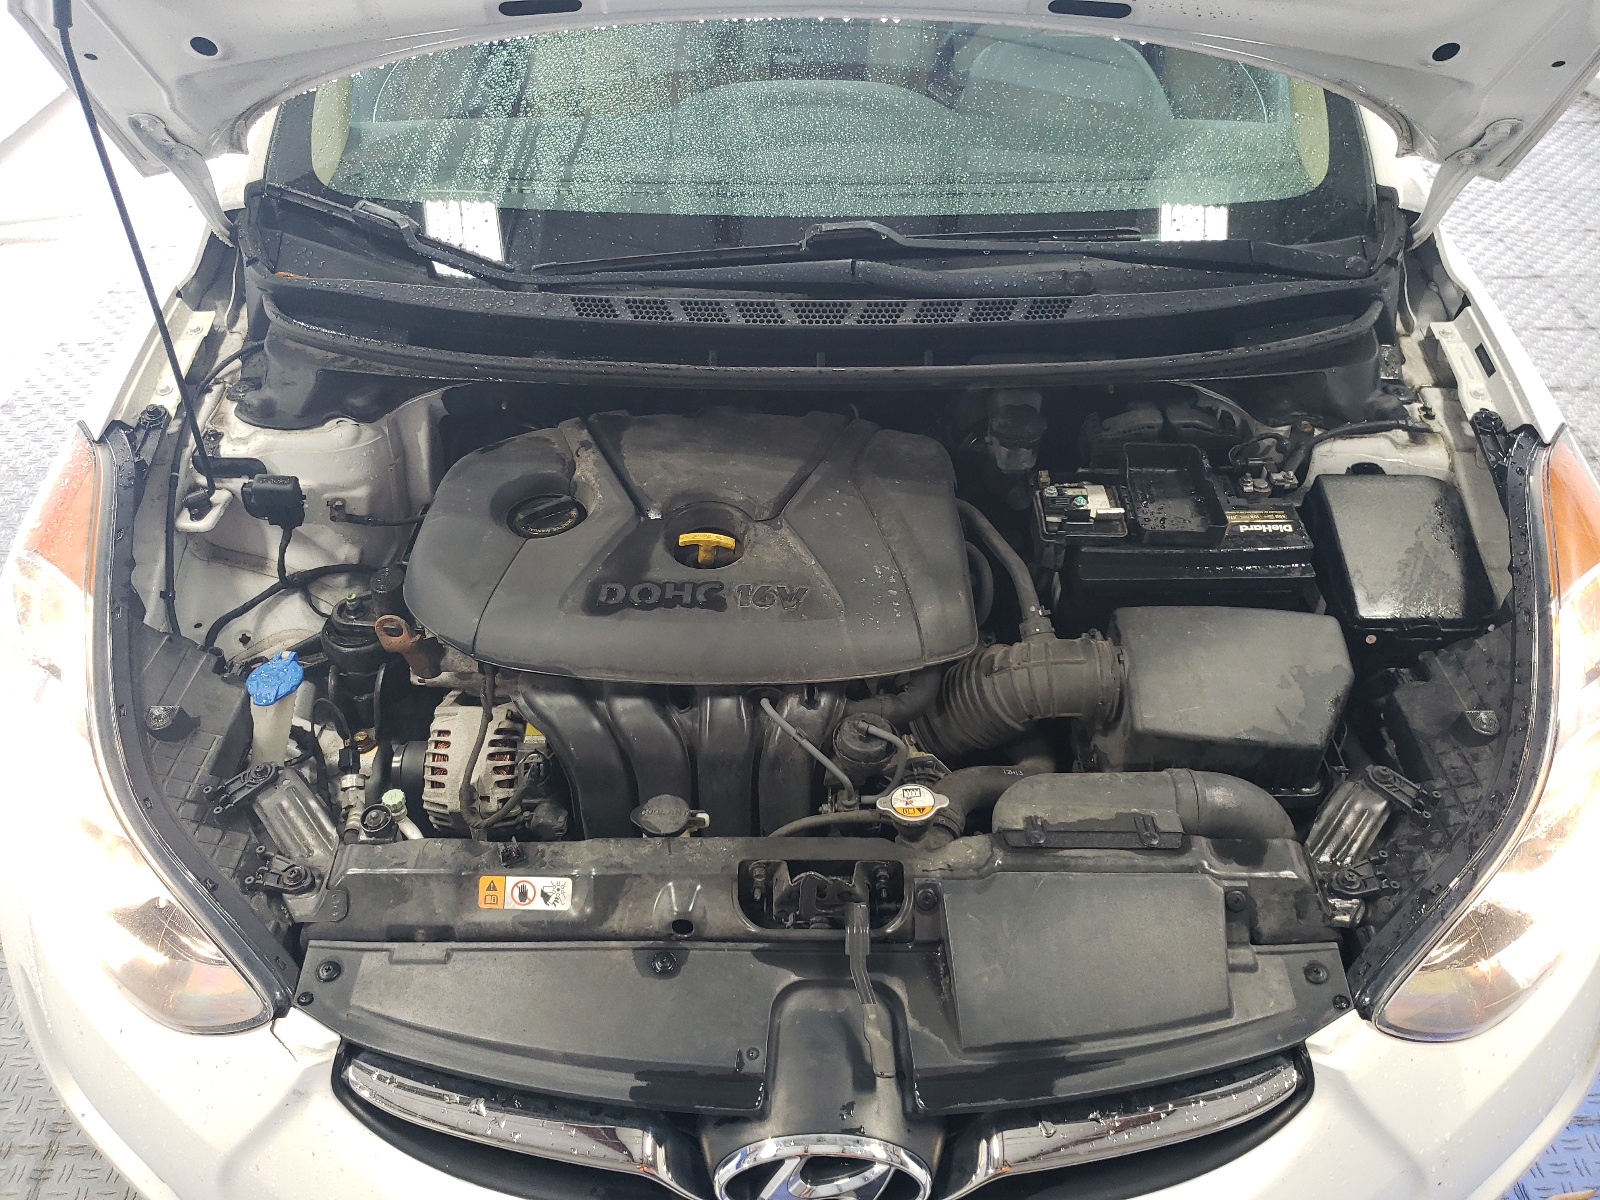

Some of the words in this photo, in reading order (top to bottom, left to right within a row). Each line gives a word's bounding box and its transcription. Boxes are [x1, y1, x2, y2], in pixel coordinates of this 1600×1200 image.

[1240, 524, 1293, 532] DieHard
[597, 581, 725, 607] DOHC
[736, 583, 808, 610] 16V
[641, 808, 690, 817] COOLANT
